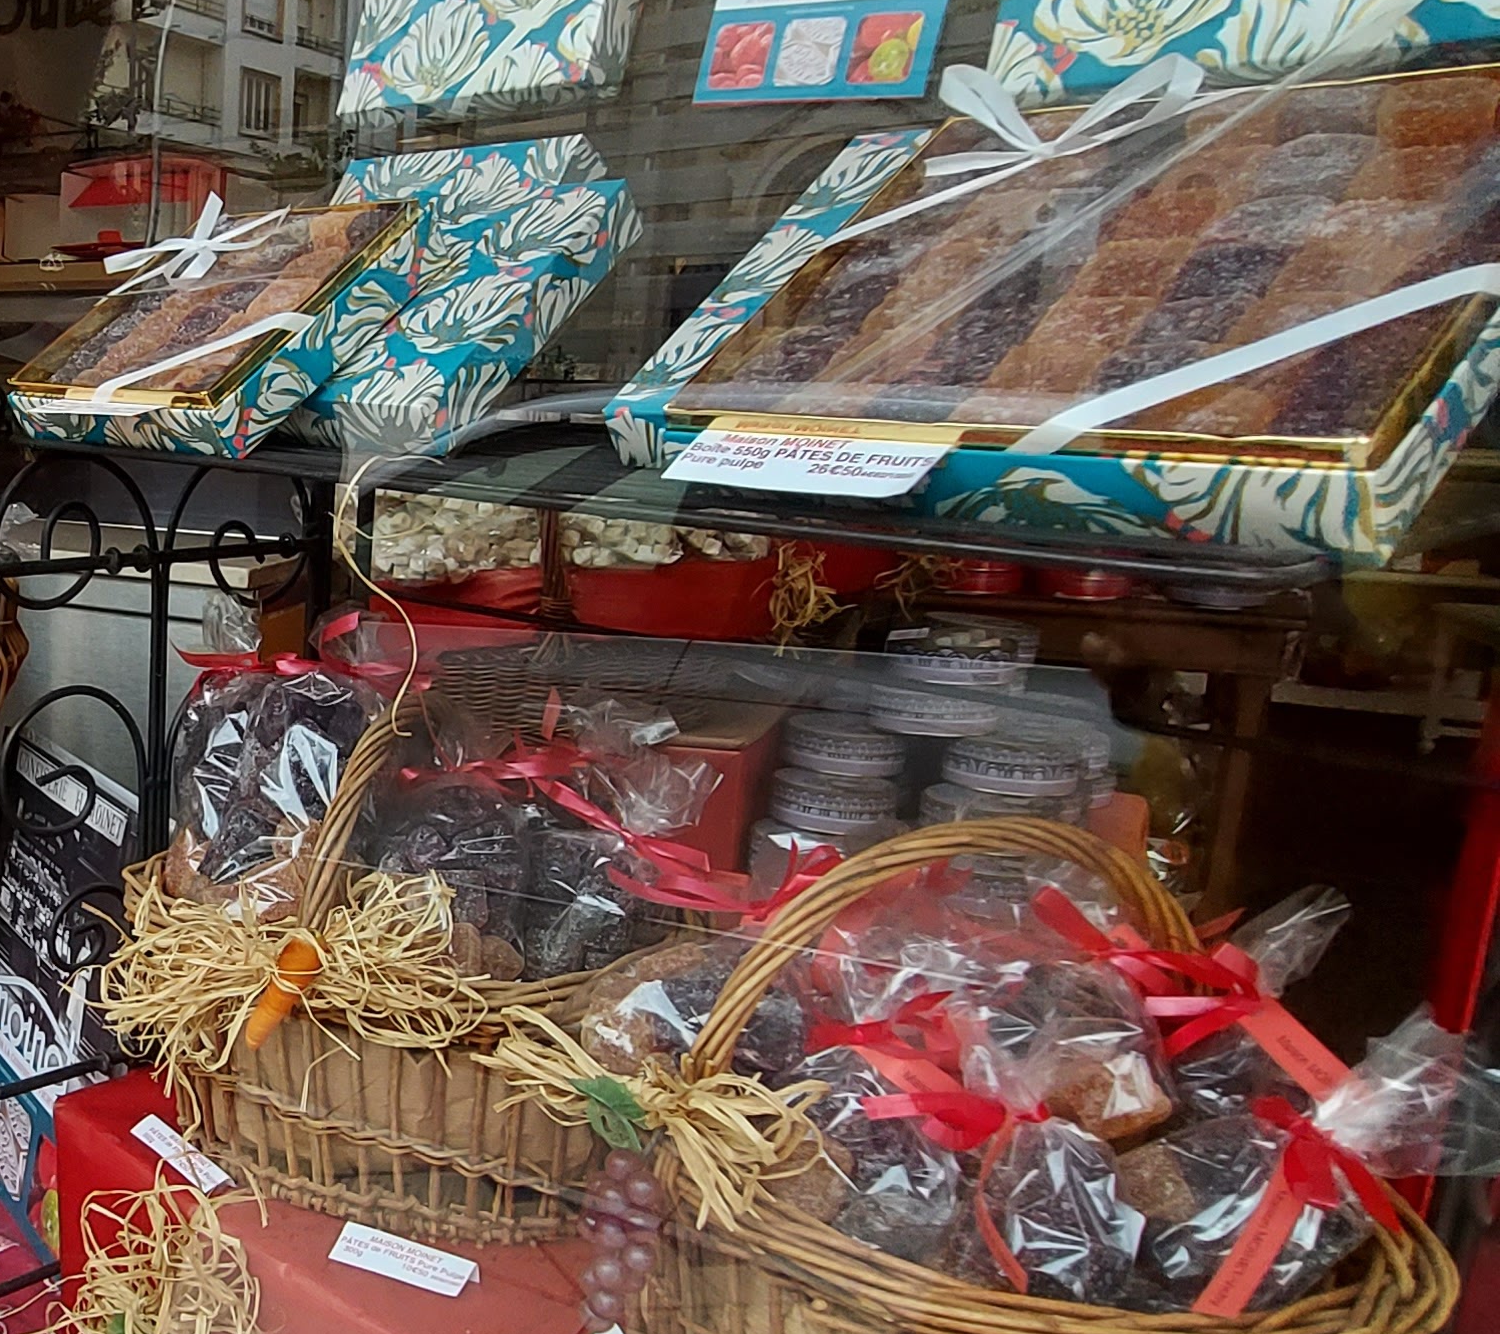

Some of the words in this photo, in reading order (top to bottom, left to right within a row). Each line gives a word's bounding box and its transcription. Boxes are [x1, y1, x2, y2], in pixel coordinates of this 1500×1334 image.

[779, 436, 854, 450] MOINET
[680, 452, 718, 465] Pure
[718, 457, 765, 471] pulpe
[835, 451, 865, 464] DE
[865, 453, 937, 468] FRUITS
[370, 1235, 405, 1253] MAISON
[406, 1246, 444, 1264] MOINET
[383, 1248, 416, 1265] FRUITS
